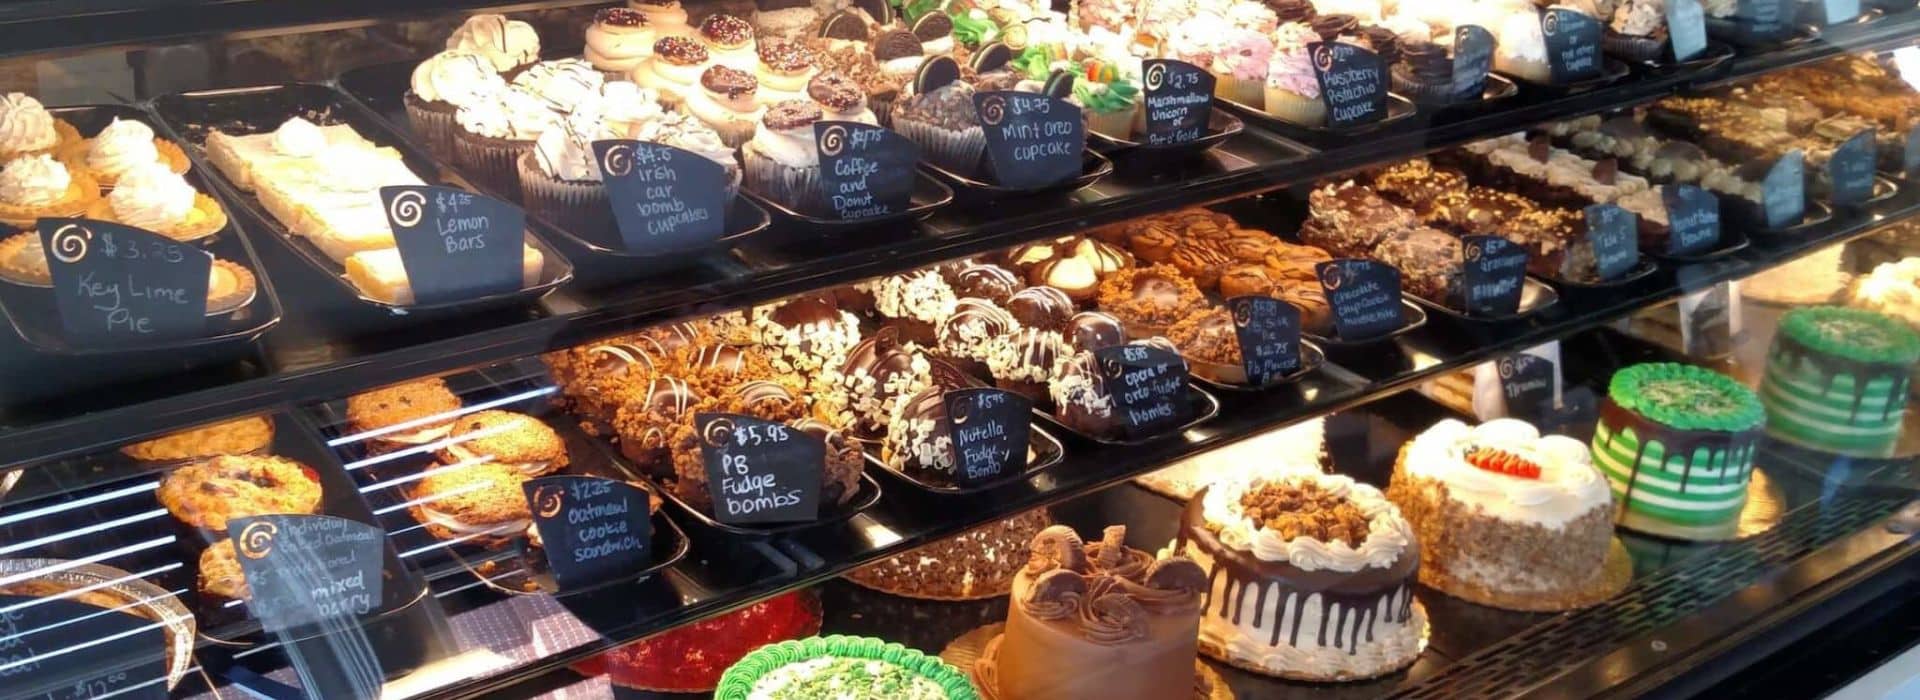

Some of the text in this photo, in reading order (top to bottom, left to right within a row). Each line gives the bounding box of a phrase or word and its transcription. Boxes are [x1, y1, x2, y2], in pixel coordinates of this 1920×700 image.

[1323, 67, 1380, 88] Raspberry
[1147, 91, 1209, 109] Marshmallow
[1001, 121, 1040, 141] Mint
[834, 158, 880, 178] Coffee
[646, 183, 673, 200] car
[839, 178, 867, 194] and
[637, 198, 685, 217] bomb
[831, 193, 873, 211] Donut
[435, 213, 489, 237] Lemon
[444, 234, 486, 254] Bars
[76, 271, 189, 311] Key Lime
[105, 307, 155, 333] Pie
[733, 424, 790, 447] $5.95
[958, 421, 1005, 447] Nutella
[721, 453, 749, 475] PB
[963, 443, 999, 467] Fudge
[721, 472, 777, 495] Fudge
[726, 488, 803, 515] bombs
[578, 520, 629, 543] cookie
[311, 569, 367, 601] mixed
[317, 592, 371, 618] berry
